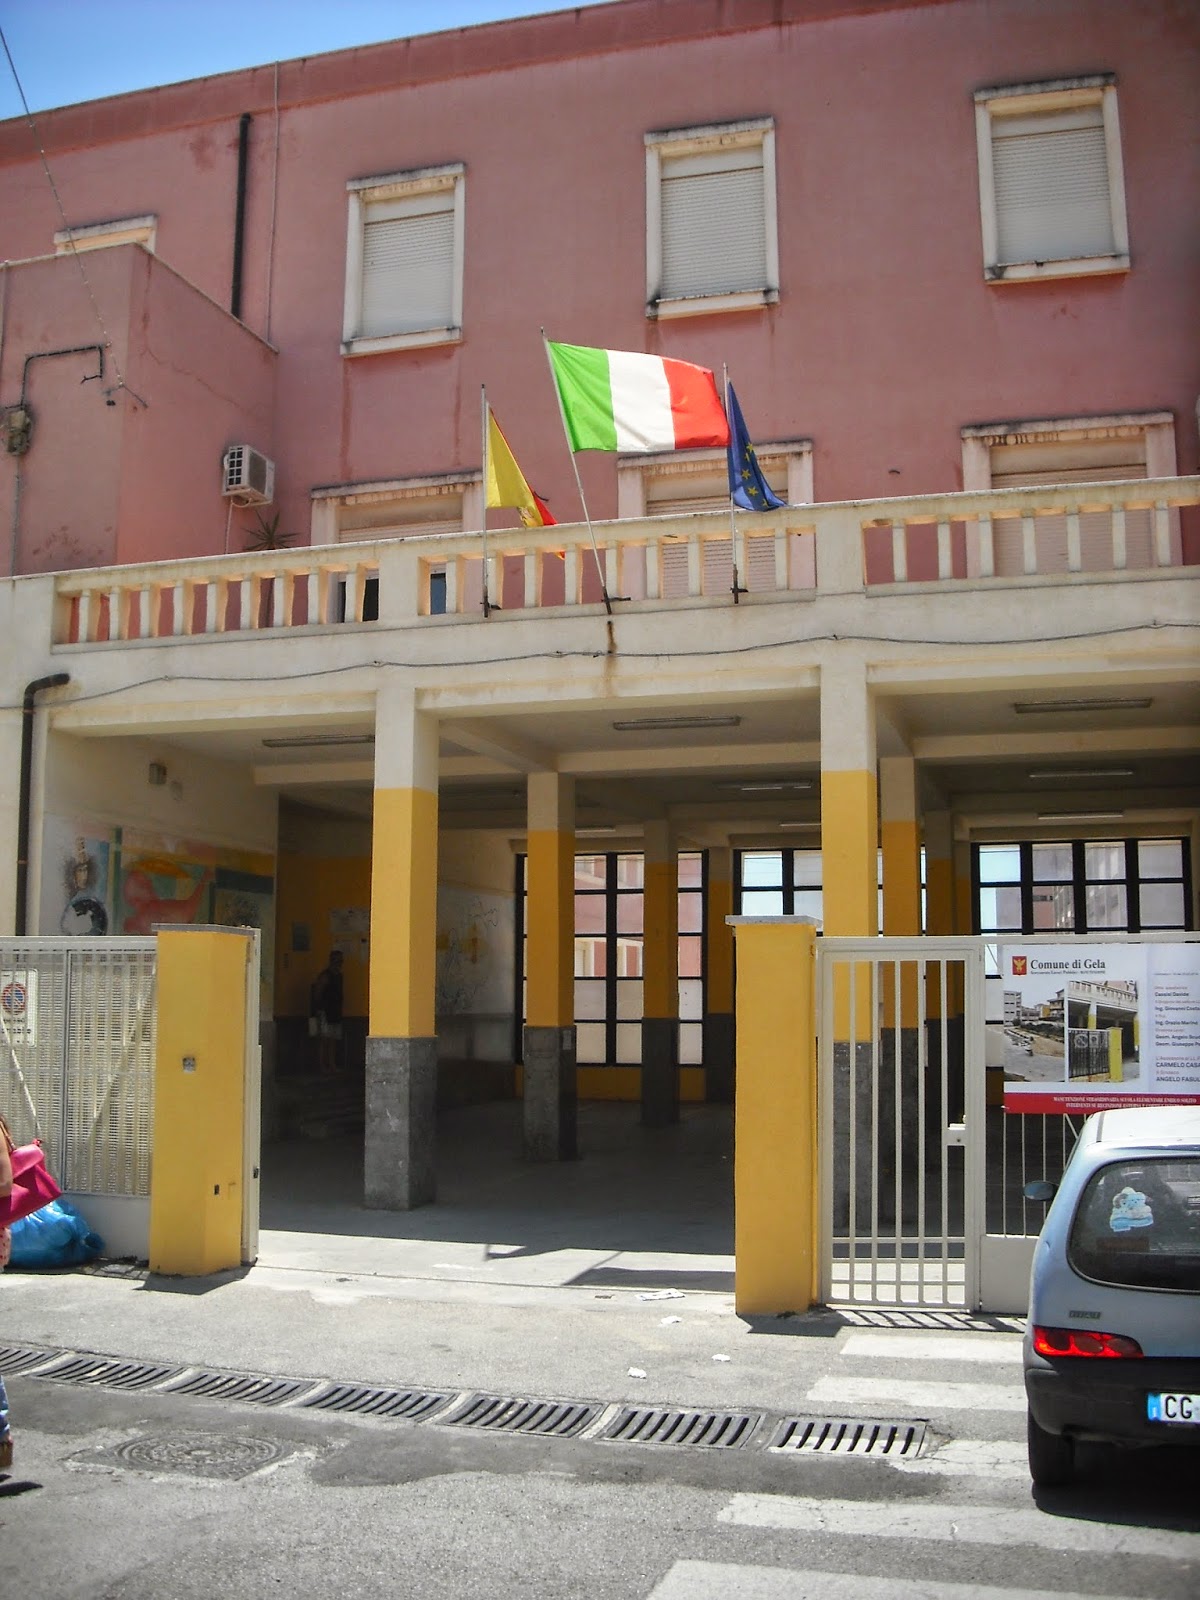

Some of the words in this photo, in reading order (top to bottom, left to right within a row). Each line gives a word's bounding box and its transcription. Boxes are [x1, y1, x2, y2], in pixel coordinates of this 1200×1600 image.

[1030, 959, 1070, 970] Comune
[1072, 959, 1081, 969] di
[1083, 958, 1106, 969] Gela
[1166, 1396, 1192, 1419] CG
